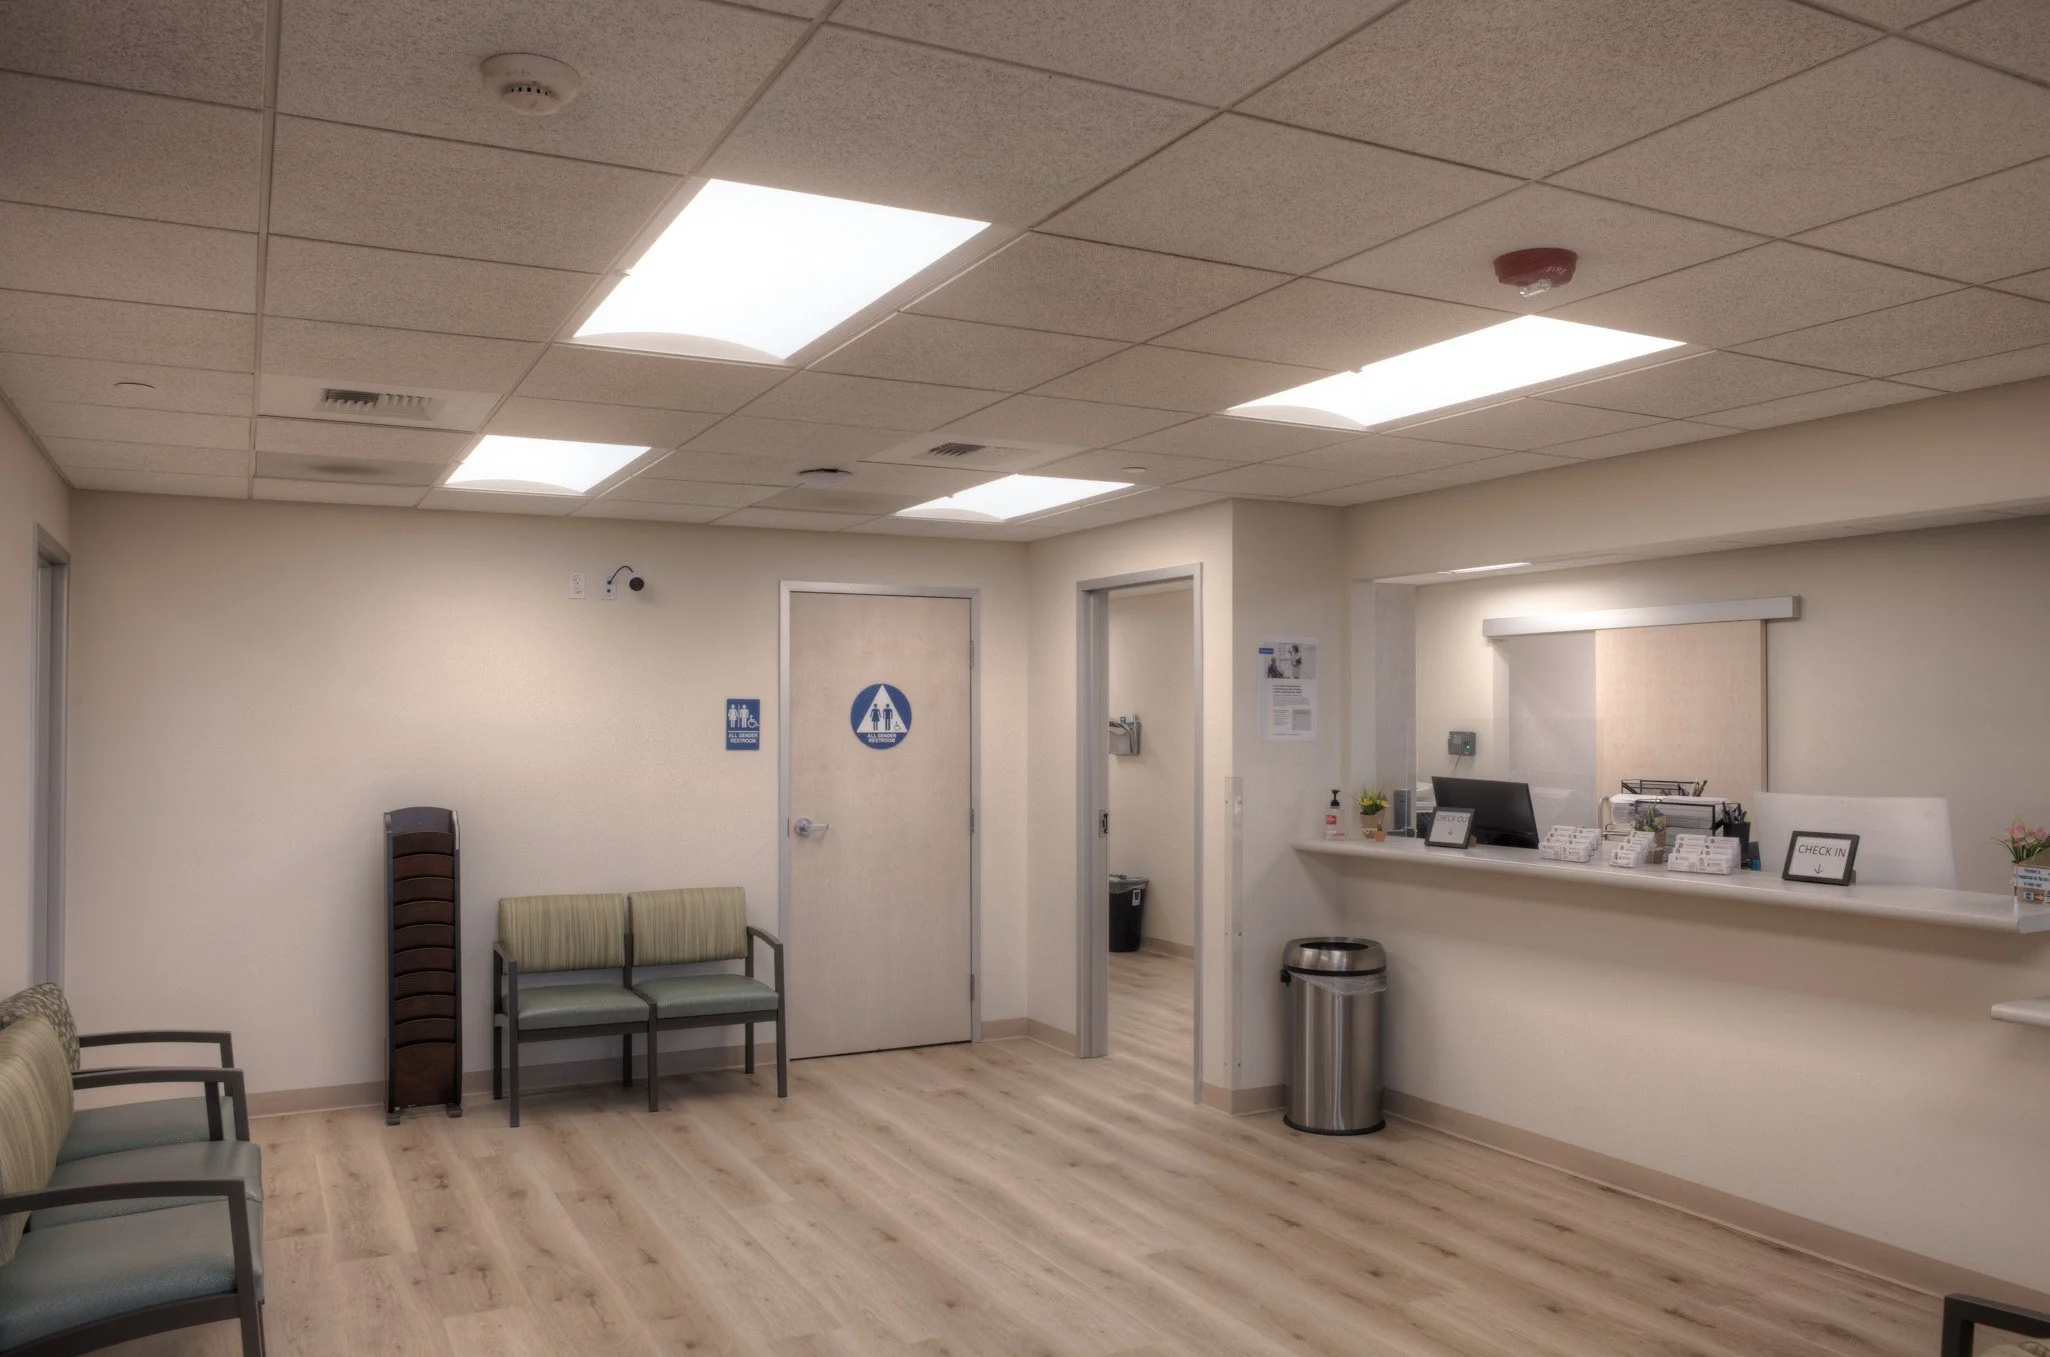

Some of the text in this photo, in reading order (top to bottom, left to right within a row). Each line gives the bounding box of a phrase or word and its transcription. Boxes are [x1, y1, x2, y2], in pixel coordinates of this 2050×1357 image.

[1546, 266, 1566, 276] FIRE
[1798, 844, 1846, 857] CHECK IN
